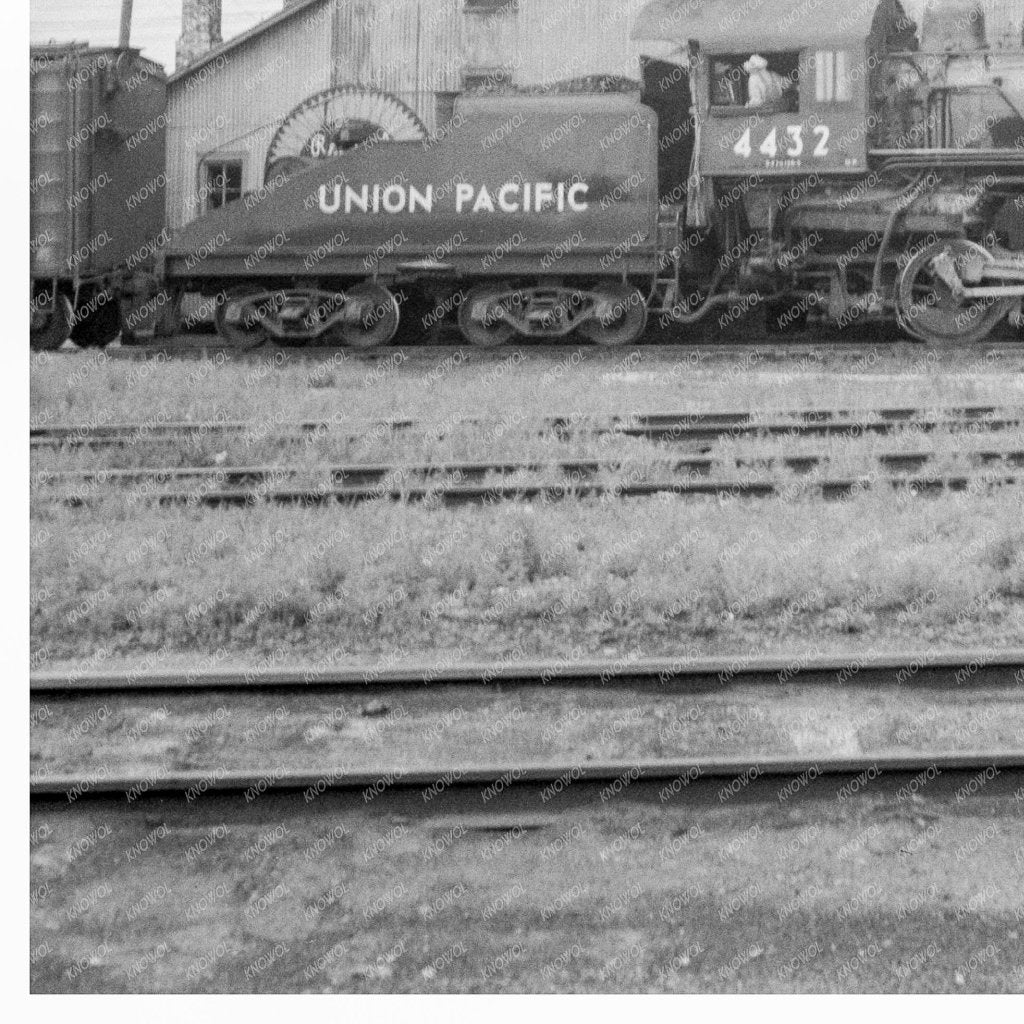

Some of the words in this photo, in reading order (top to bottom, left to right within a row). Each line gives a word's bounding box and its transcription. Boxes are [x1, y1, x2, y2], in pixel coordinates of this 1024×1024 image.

[733, 125, 830, 158] 4432
[318, 183, 433, 214] UNION
[455, 182, 589, 213] PACIFIC
